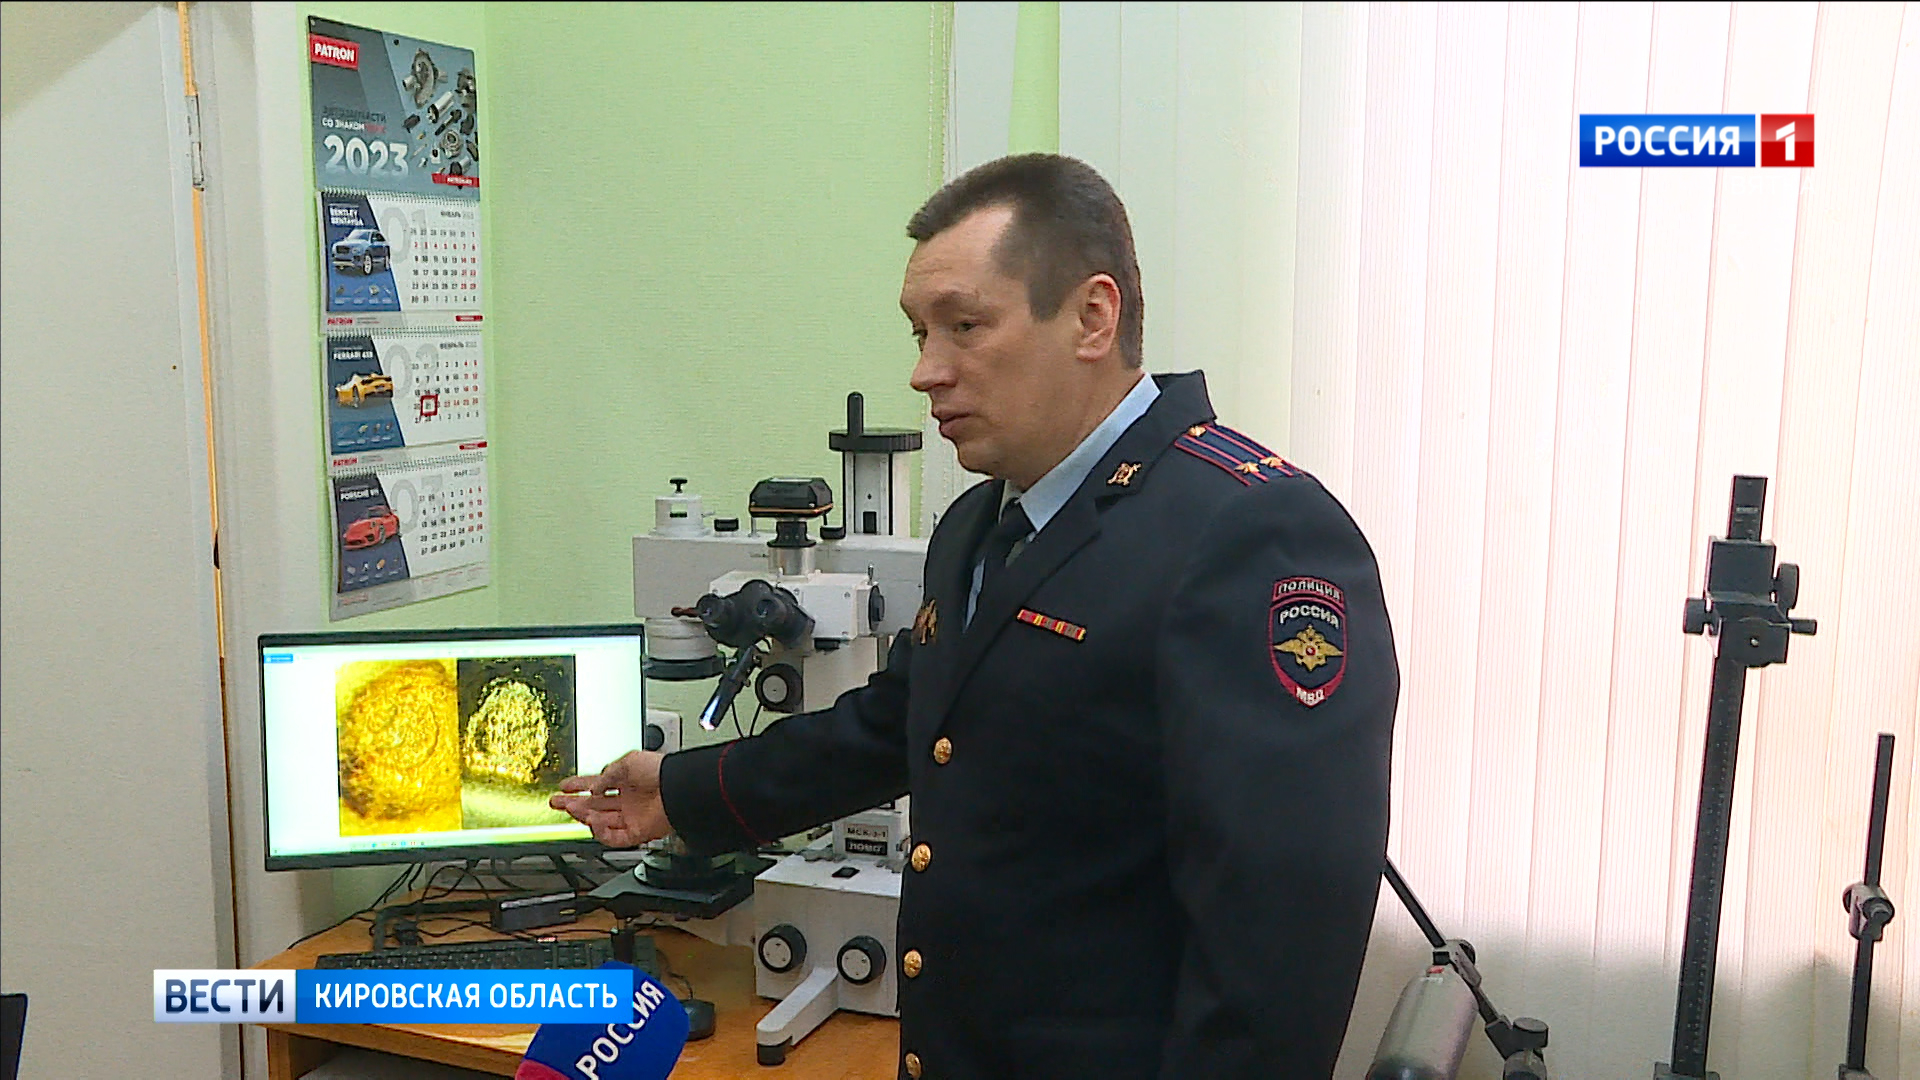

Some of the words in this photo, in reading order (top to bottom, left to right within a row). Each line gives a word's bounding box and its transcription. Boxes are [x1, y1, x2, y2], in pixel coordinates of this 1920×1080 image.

[314, 43, 355, 61] PATRON
[324, 135, 409, 177] 2023
[1278, 580, 1340, 600] ПОЛИЦИЯ
[1280, 604, 1339, 629] РОССИЯ
[1295, 687, 1325, 706] МВД
